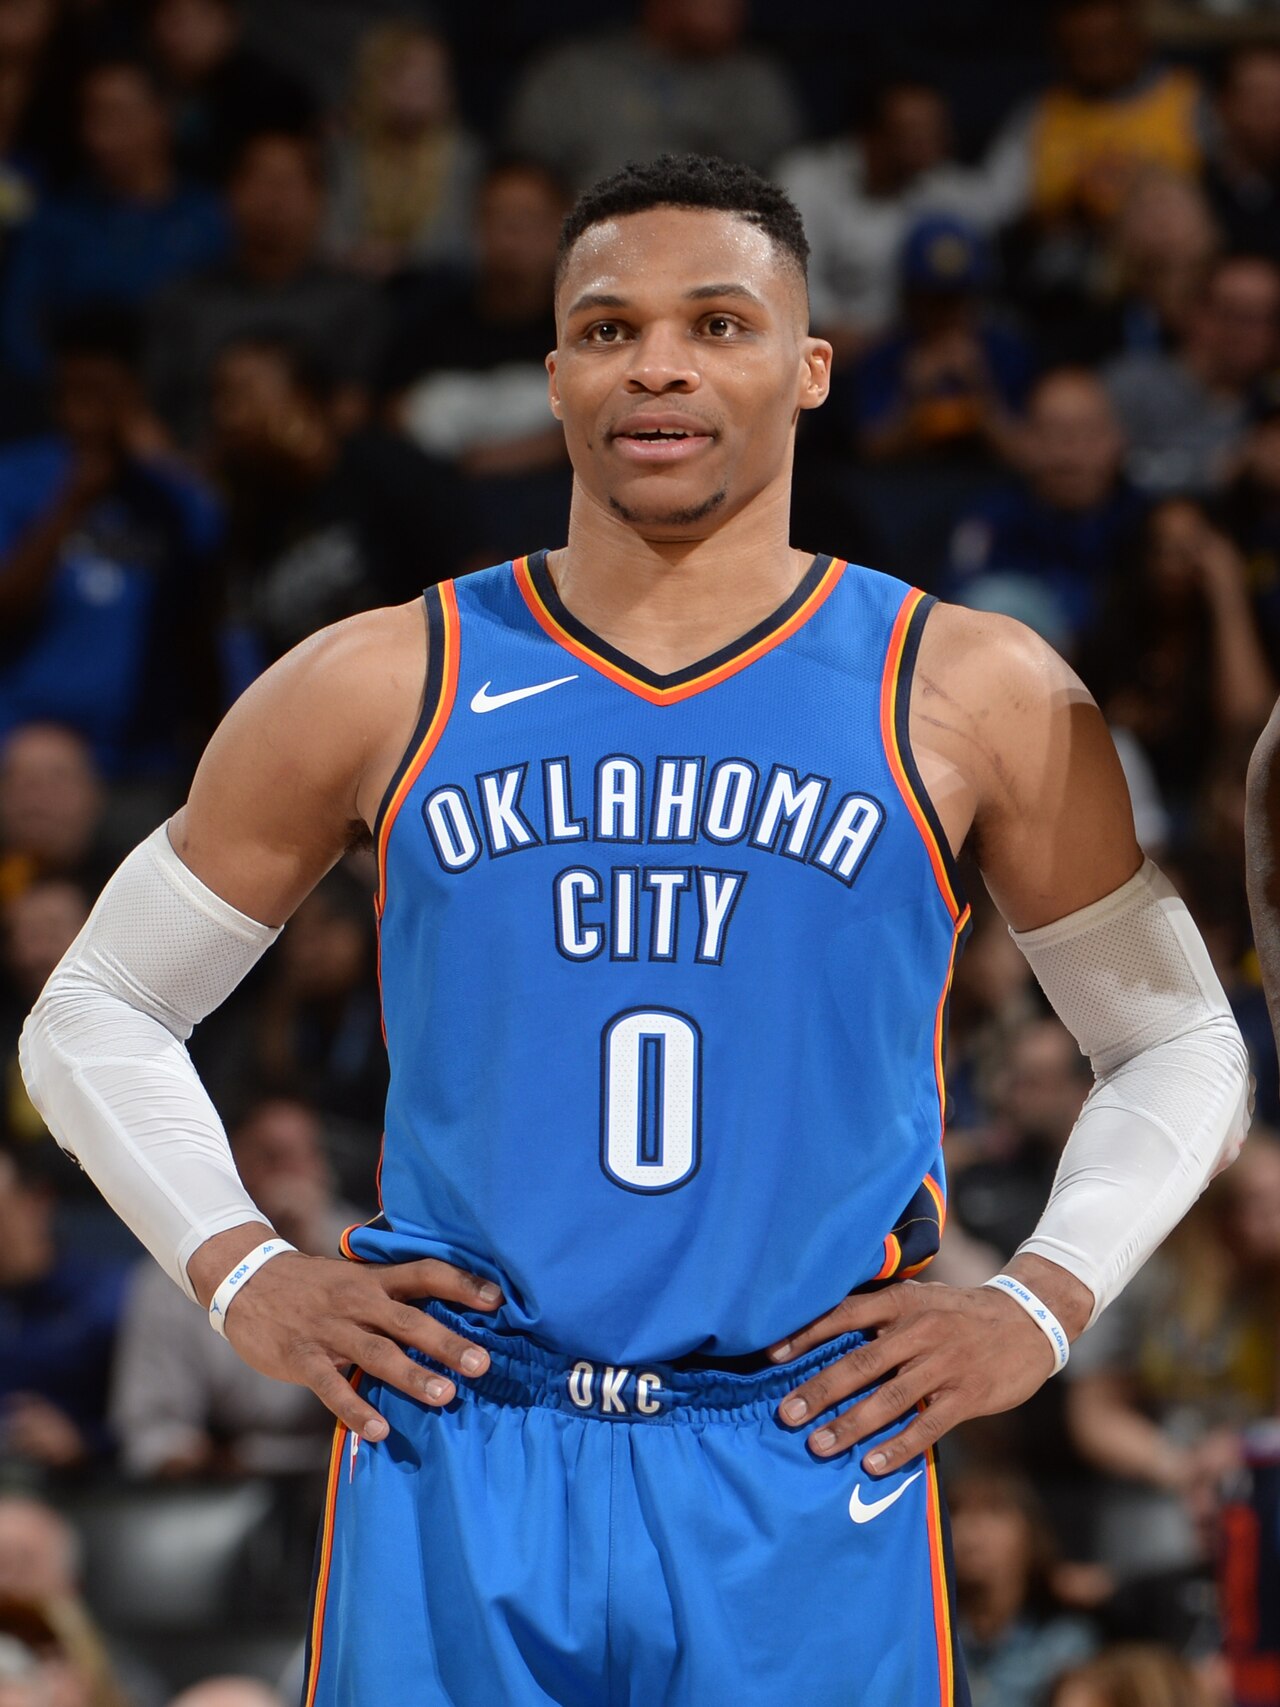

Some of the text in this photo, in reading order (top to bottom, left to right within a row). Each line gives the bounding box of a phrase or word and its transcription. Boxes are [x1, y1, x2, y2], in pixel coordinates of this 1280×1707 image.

[421, 753, 887, 888] OKLAHOMA
[552, 864, 748, 966] CITY
[600, 1004, 703, 1196] 0
[229, 1264, 250, 1285] KB3
[1014, 1287, 1031, 1302] WHY
[1051, 1327, 1064, 1348] NOT?
[567, 1359, 663, 1416] OKC
